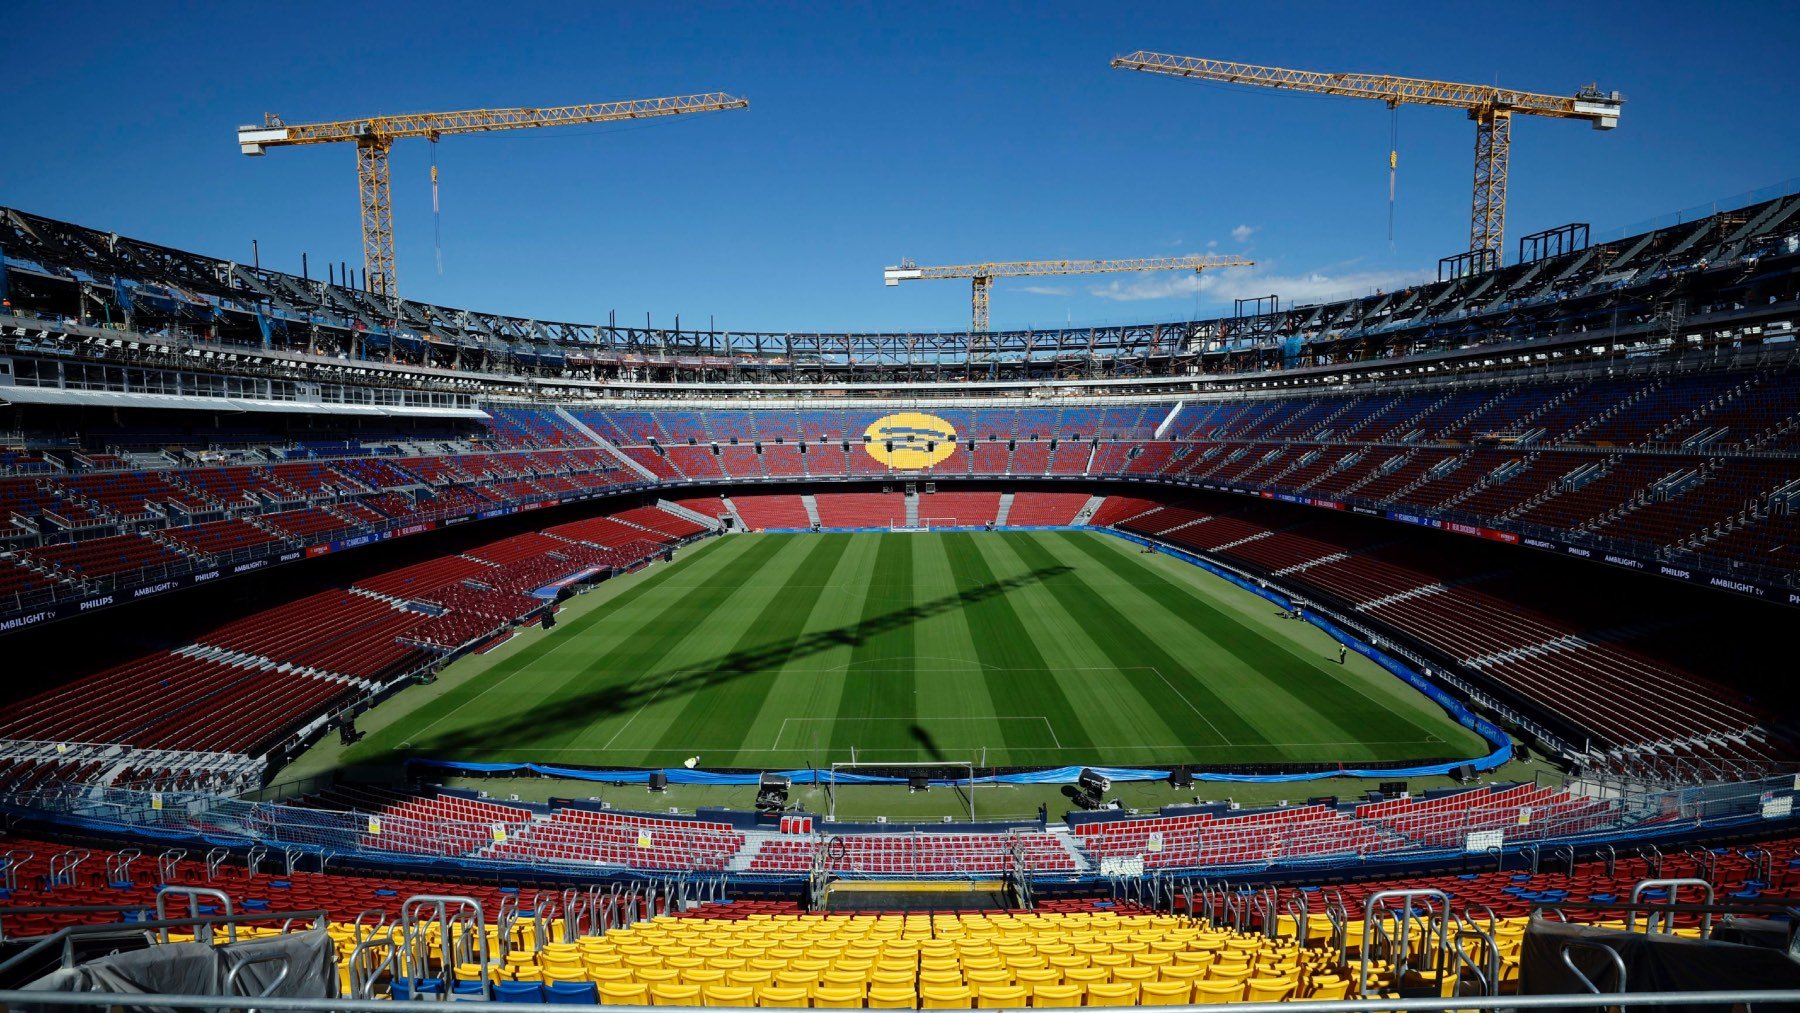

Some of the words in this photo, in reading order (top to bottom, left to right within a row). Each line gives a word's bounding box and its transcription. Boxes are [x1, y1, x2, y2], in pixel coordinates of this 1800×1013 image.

[1524, 538, 1550, 549] AMBILIGHT
[280, 552, 300, 562] PHILIPS
[1568, 547, 1591, 557] PHILIPS
[234, 560, 263, 573] AMBILIGHT
[1604, 554, 1636, 568] AMBILIGHT
[195, 570, 220, 582] PHILIPS
[1661, 566, 1690, 579] PHILIPS
[134, 582, 171, 598] AMBILIGHT
[171, 580, 179, 588] tv
[1710, 577, 1755, 594] AMBILIGHT
[1755, 587, 1764, 596] tv
[80, 595, 113, 611] PHILIPS
[0, 611, 46, 630] MBILIGHT
[47, 611, 56, 619] tv
